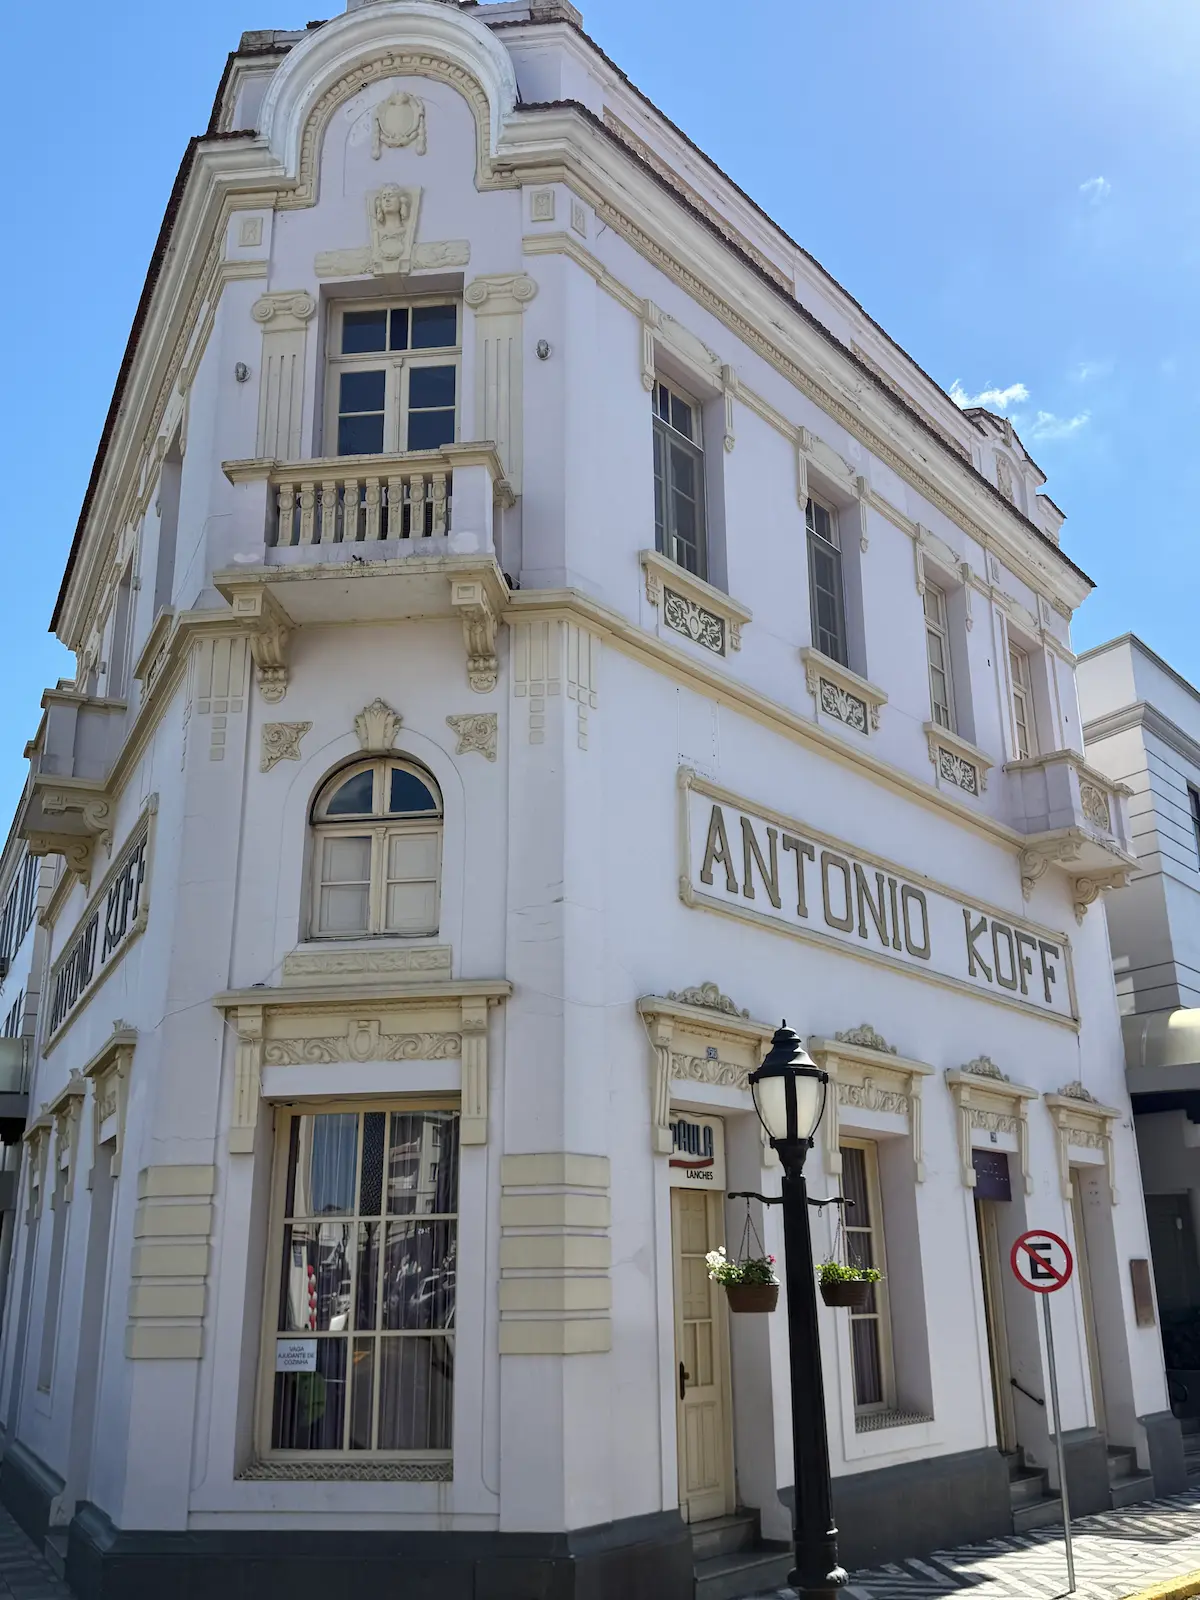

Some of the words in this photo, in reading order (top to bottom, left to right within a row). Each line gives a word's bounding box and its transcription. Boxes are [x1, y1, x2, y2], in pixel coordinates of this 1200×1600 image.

[102, 831, 148, 964] KOFF
[701, 805, 931, 960] ANTONIO
[962, 908, 1060, 1003] KOFF
[686, 1169, 714, 1180] LANCHES
[1027, 1243, 1056, 1279] E
